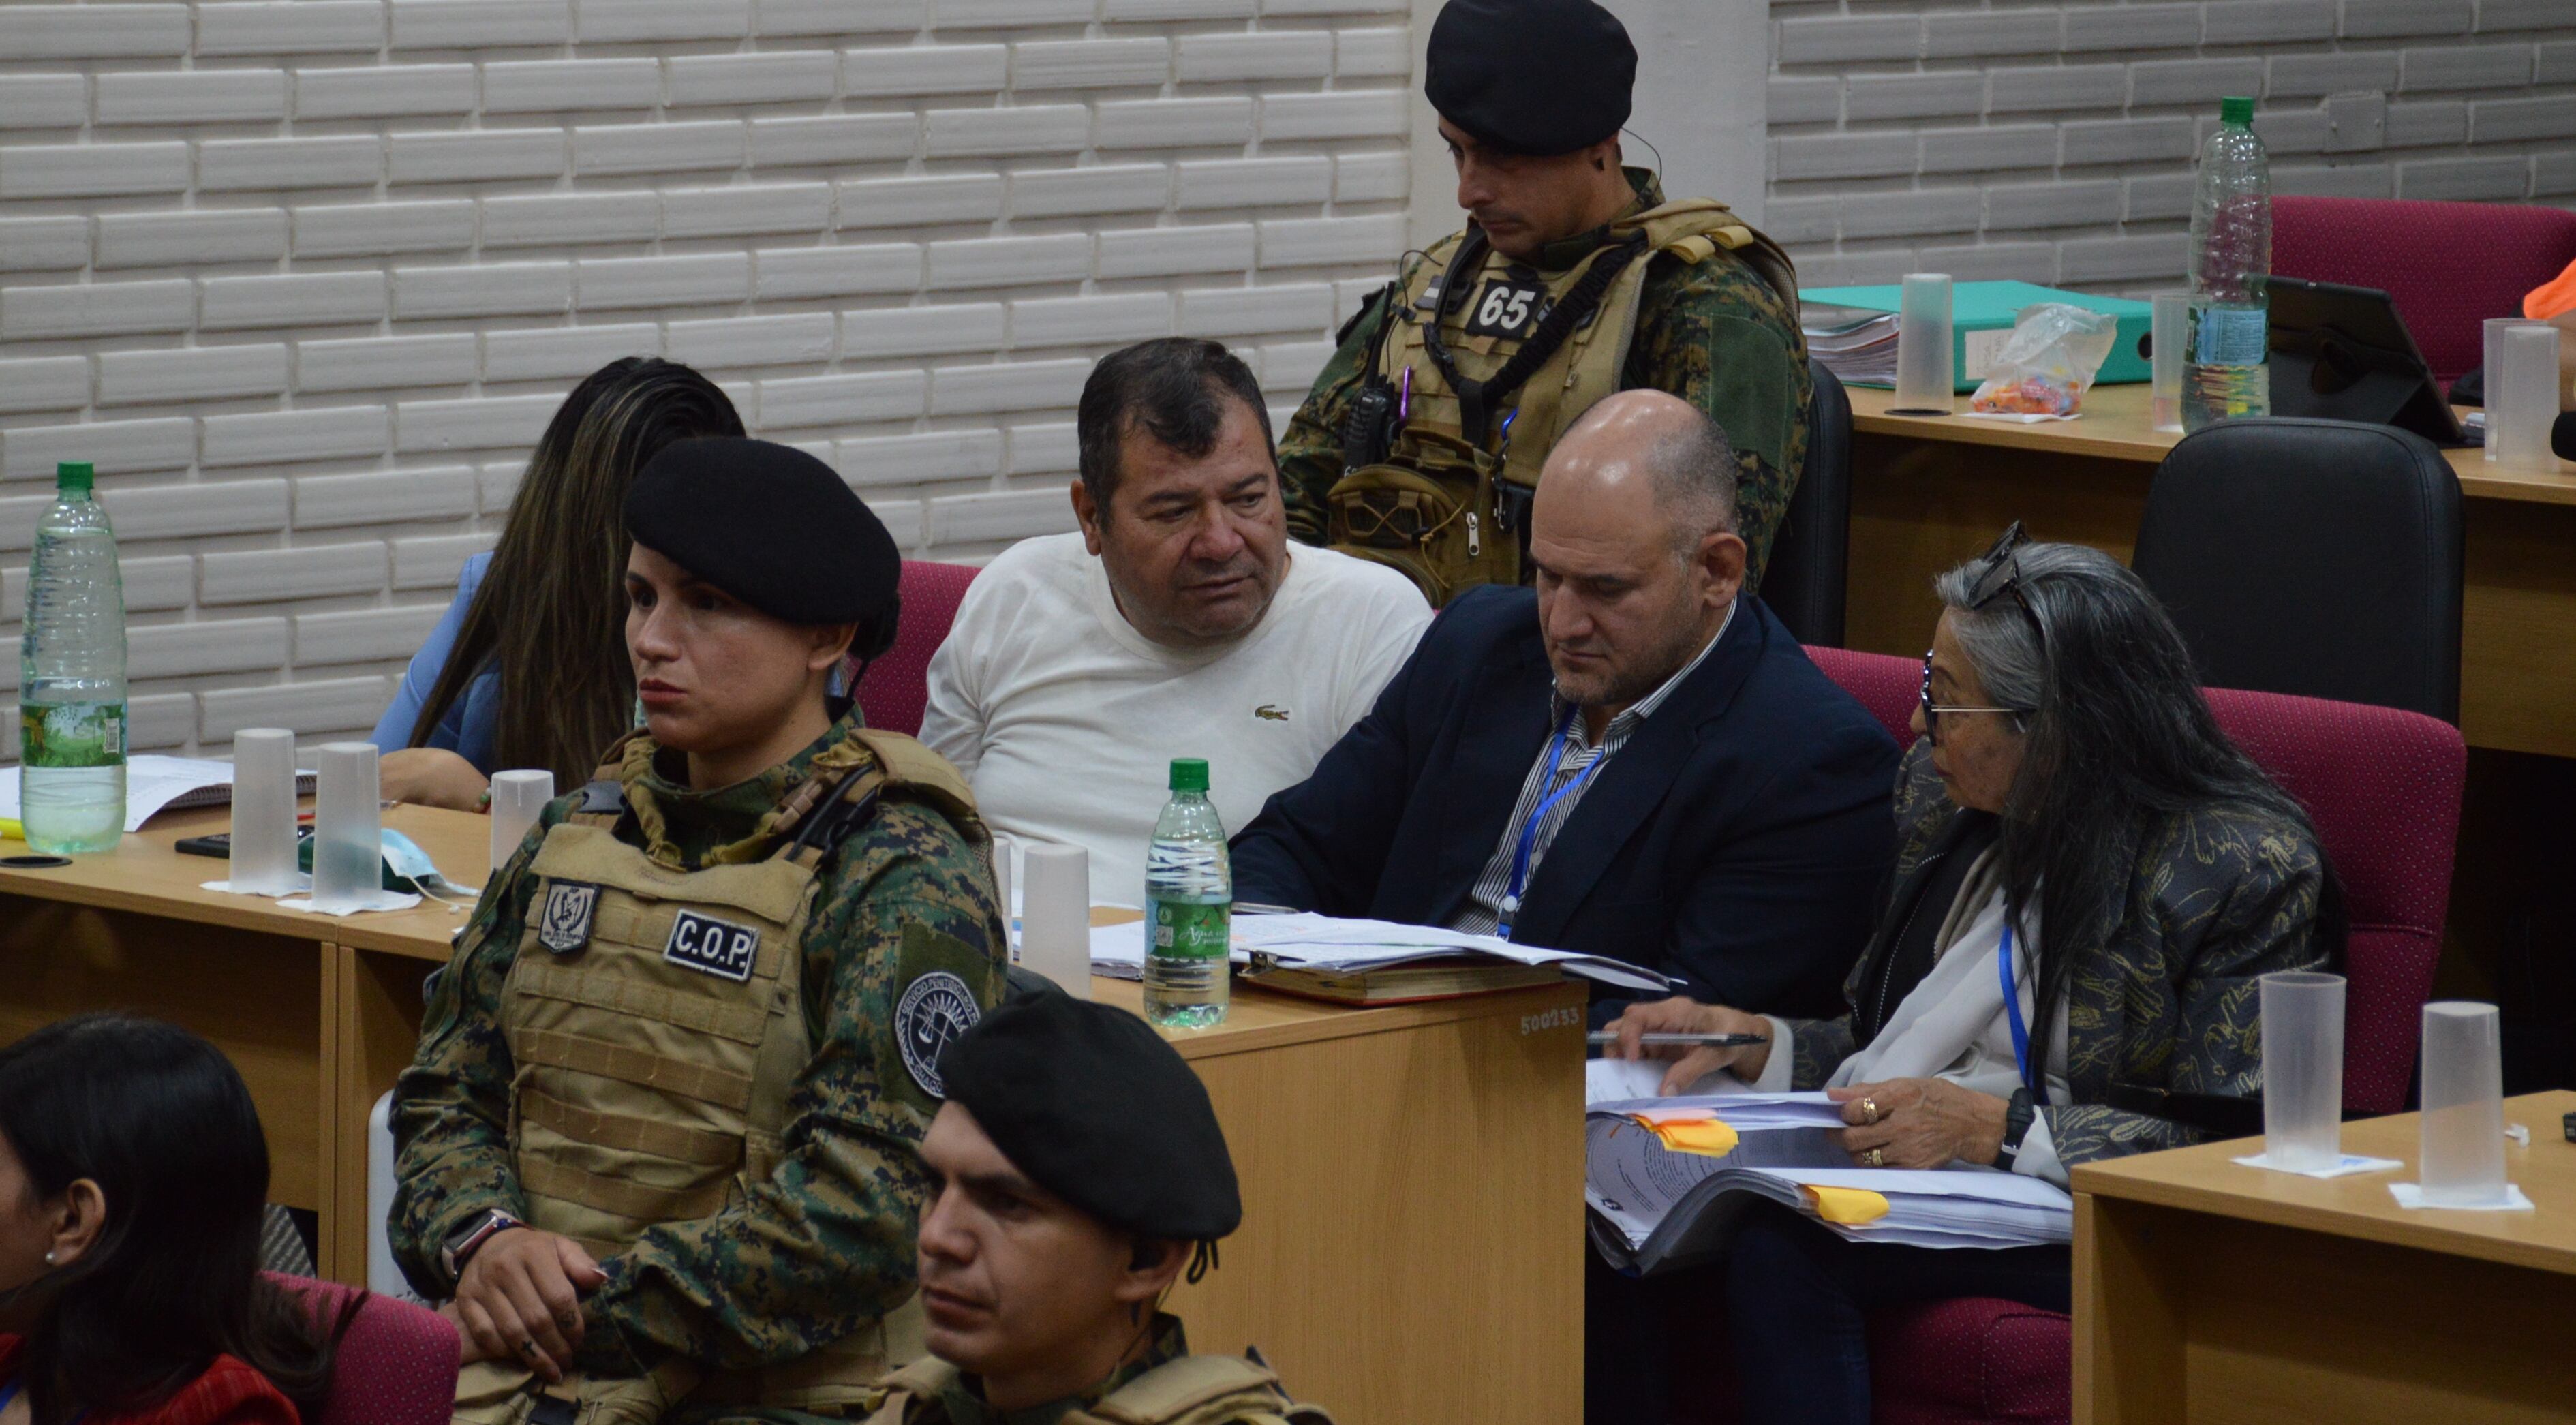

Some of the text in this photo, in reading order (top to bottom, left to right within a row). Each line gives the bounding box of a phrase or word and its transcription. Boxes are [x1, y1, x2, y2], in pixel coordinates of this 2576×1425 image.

[1479, 286, 1536, 329] 65
[902, 981, 927, 1015] SERVICIO
[914, 1064, 942, 1092] CHACO
